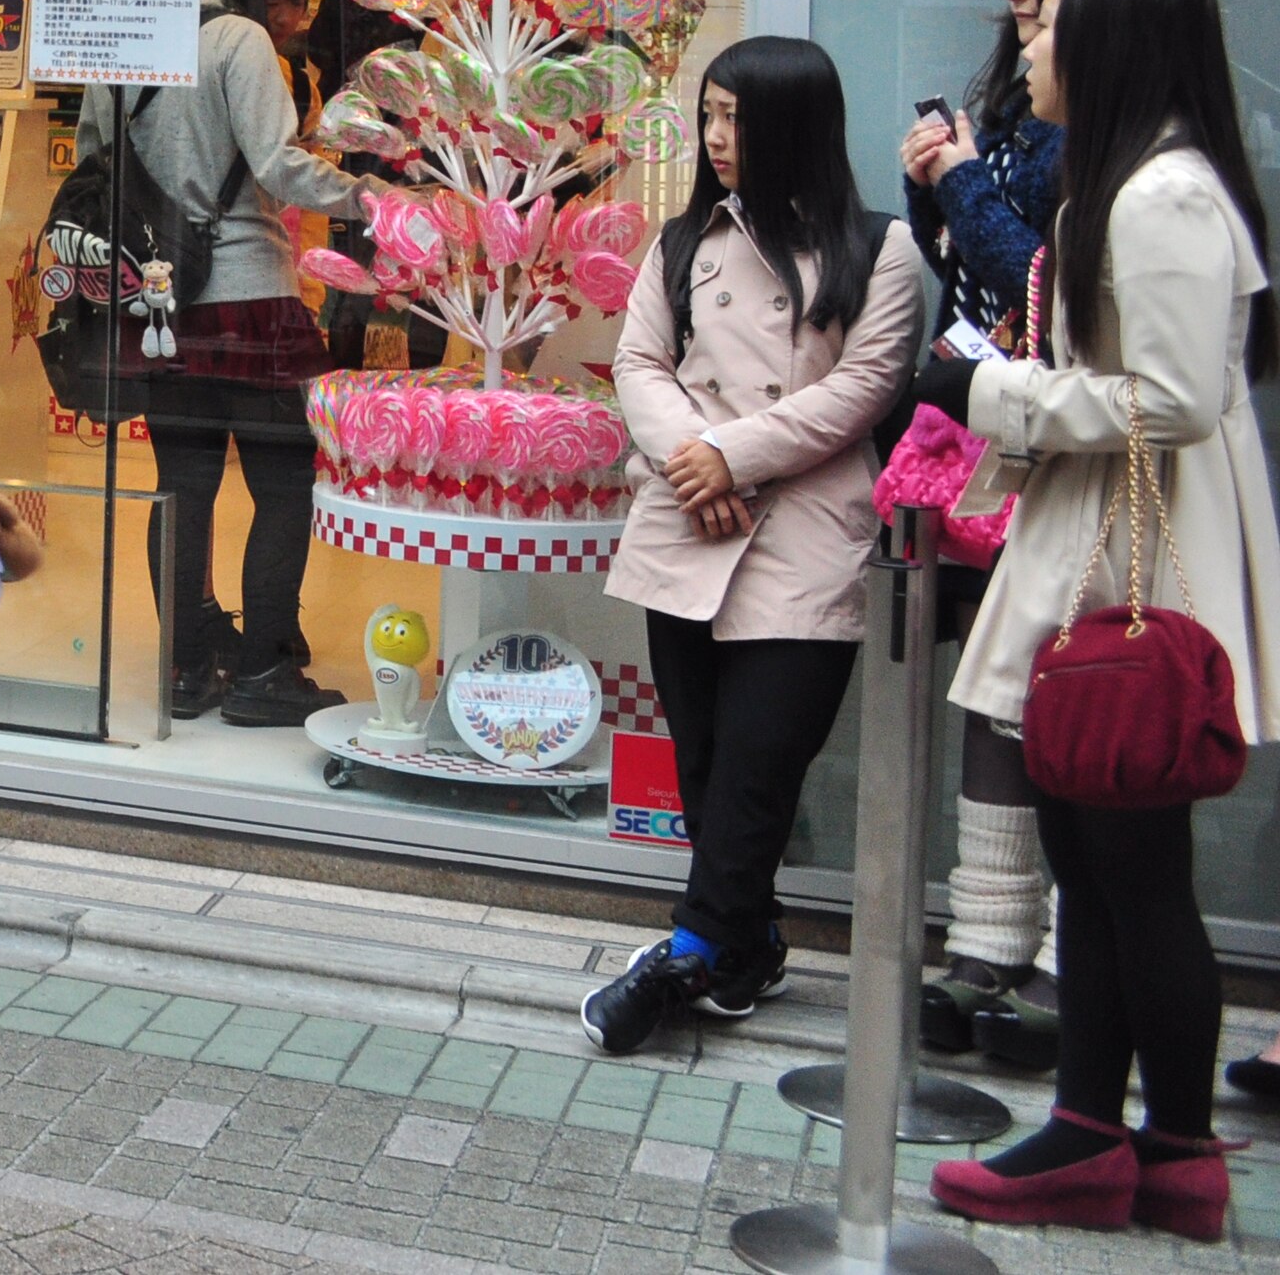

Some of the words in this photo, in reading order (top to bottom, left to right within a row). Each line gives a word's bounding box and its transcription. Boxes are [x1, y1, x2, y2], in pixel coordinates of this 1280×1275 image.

[502, 725, 541, 751] CANDY
[647, 786, 681, 799] Securi
[660, 798, 672, 810] by
[615, 807, 690, 840] SECO
